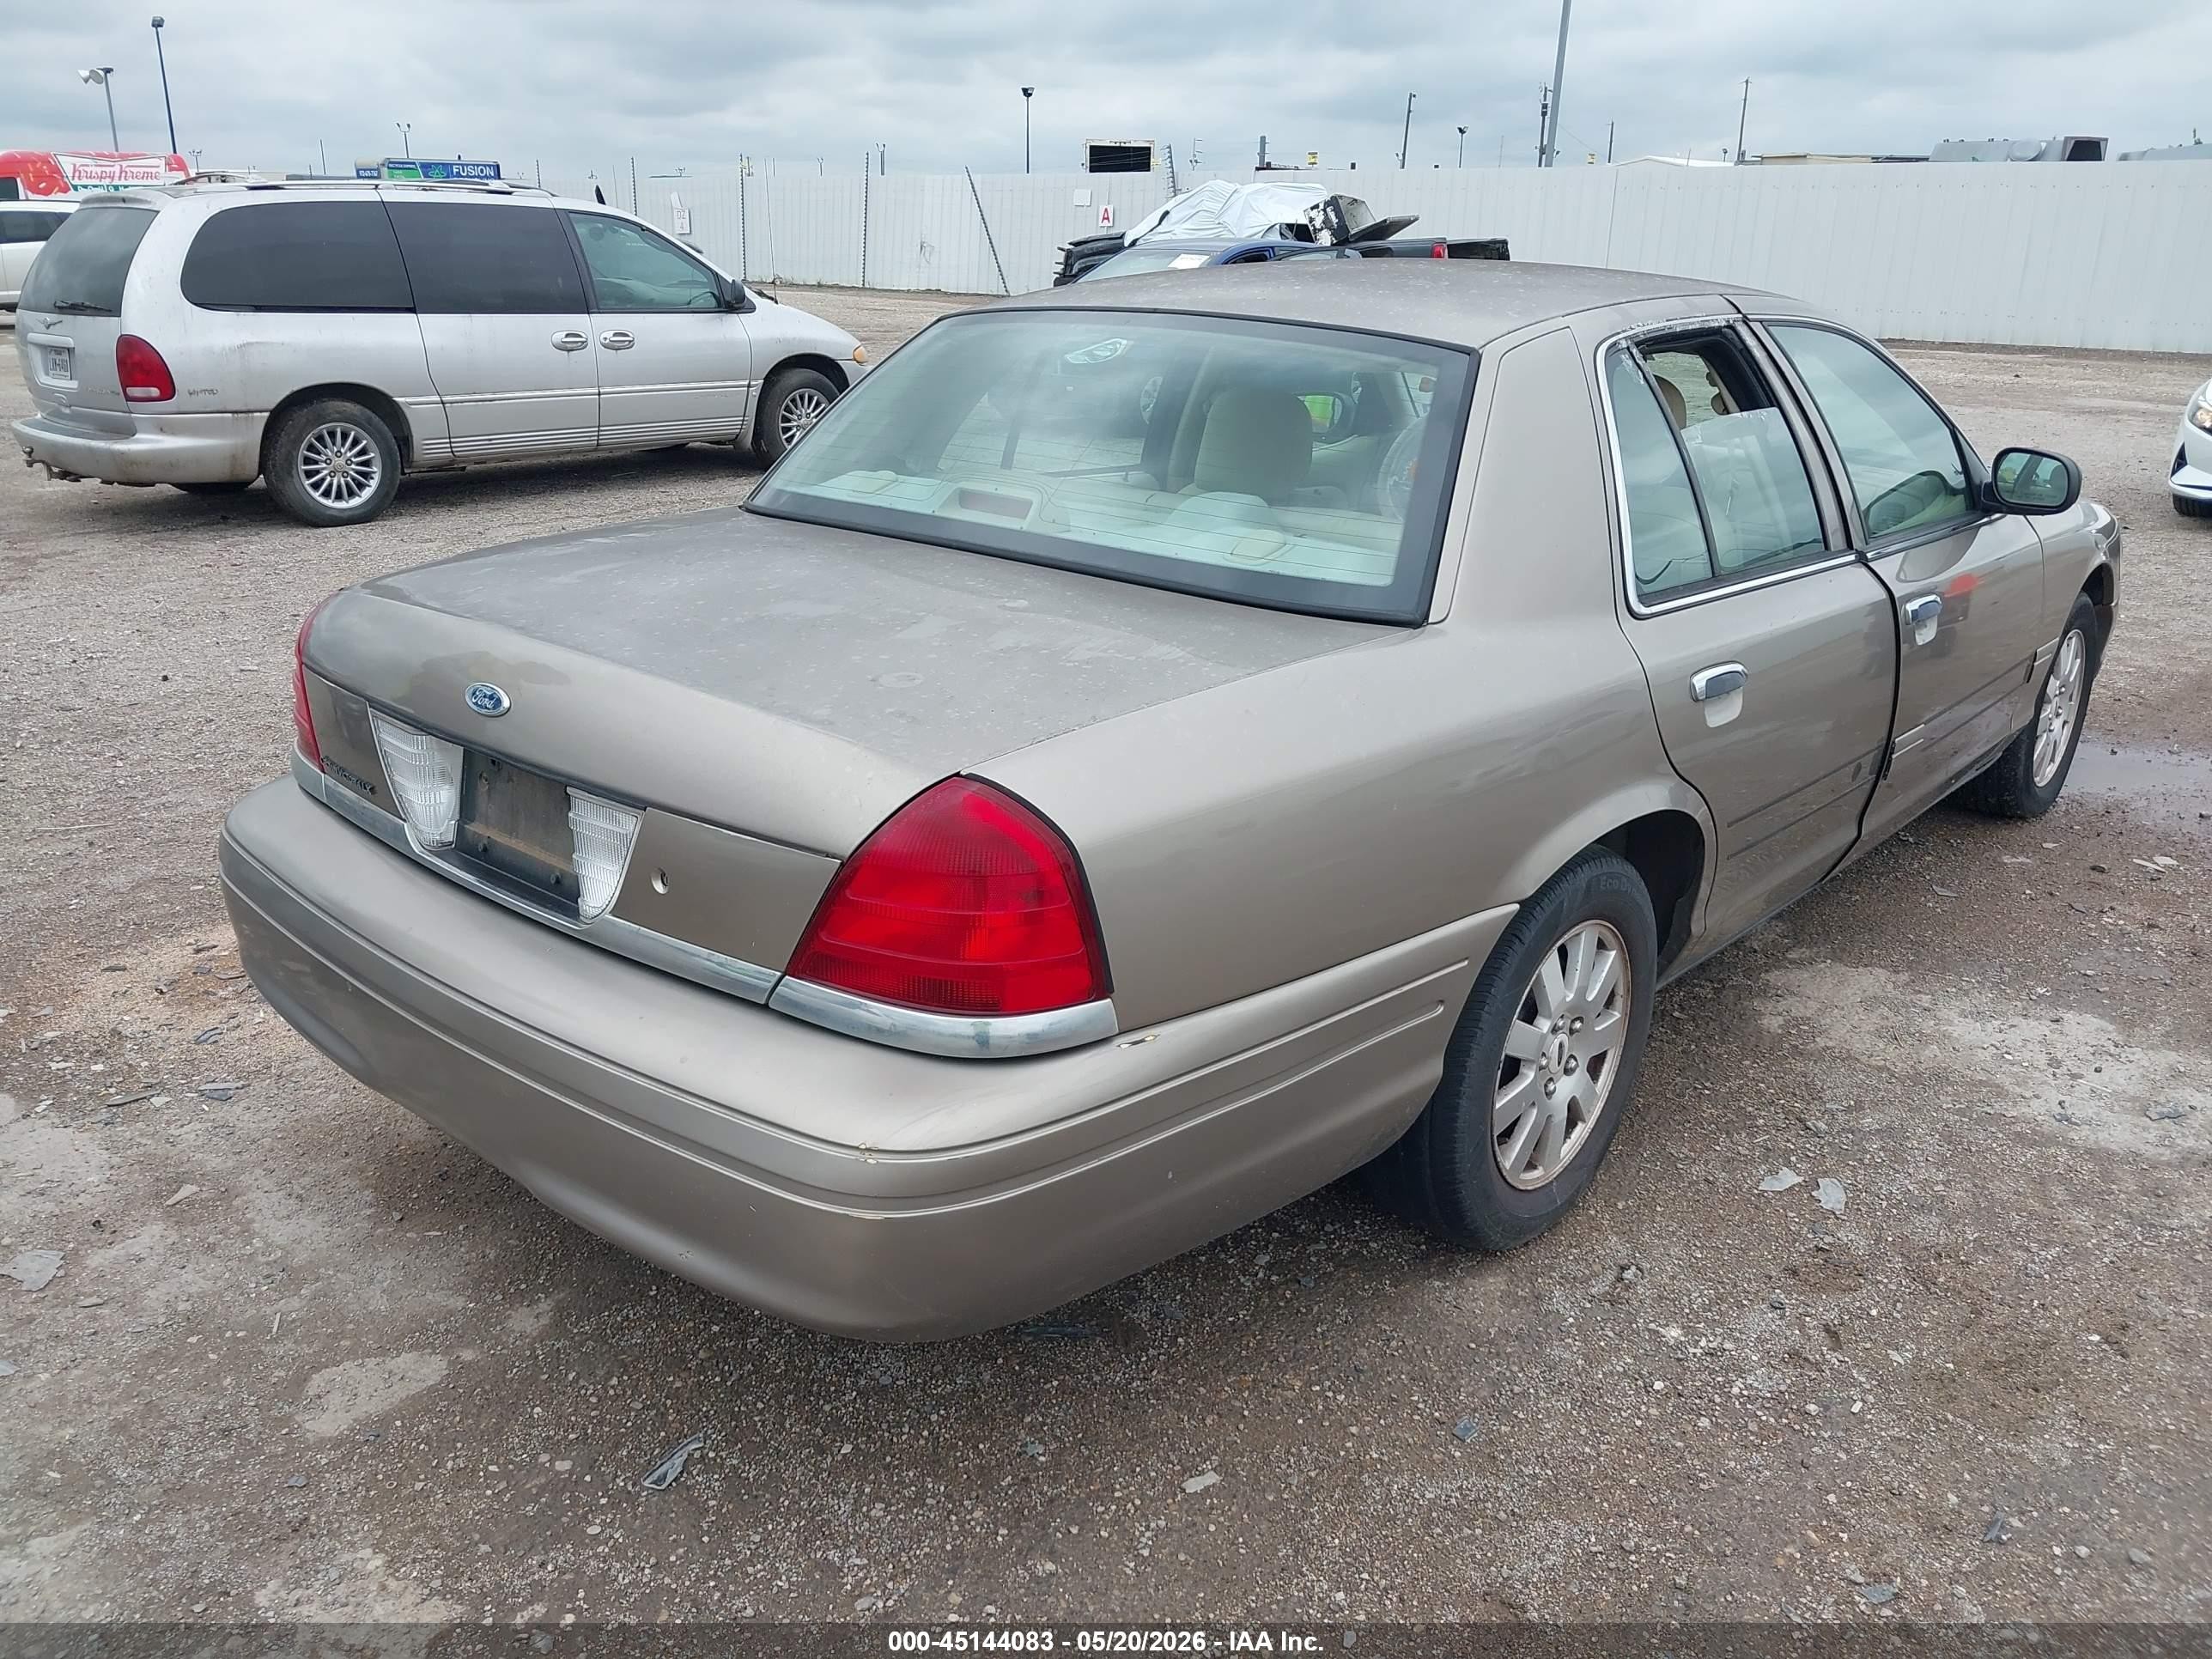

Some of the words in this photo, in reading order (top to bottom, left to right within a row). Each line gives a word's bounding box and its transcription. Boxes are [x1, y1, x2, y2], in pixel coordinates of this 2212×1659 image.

[71, 163, 116, 184] Krispy
[117, 163, 161, 181] Kreme
[453, 166, 495, 177] FUSION
[1101, 207, 1110, 223] A
[472, 687, 497, 708] Ford
